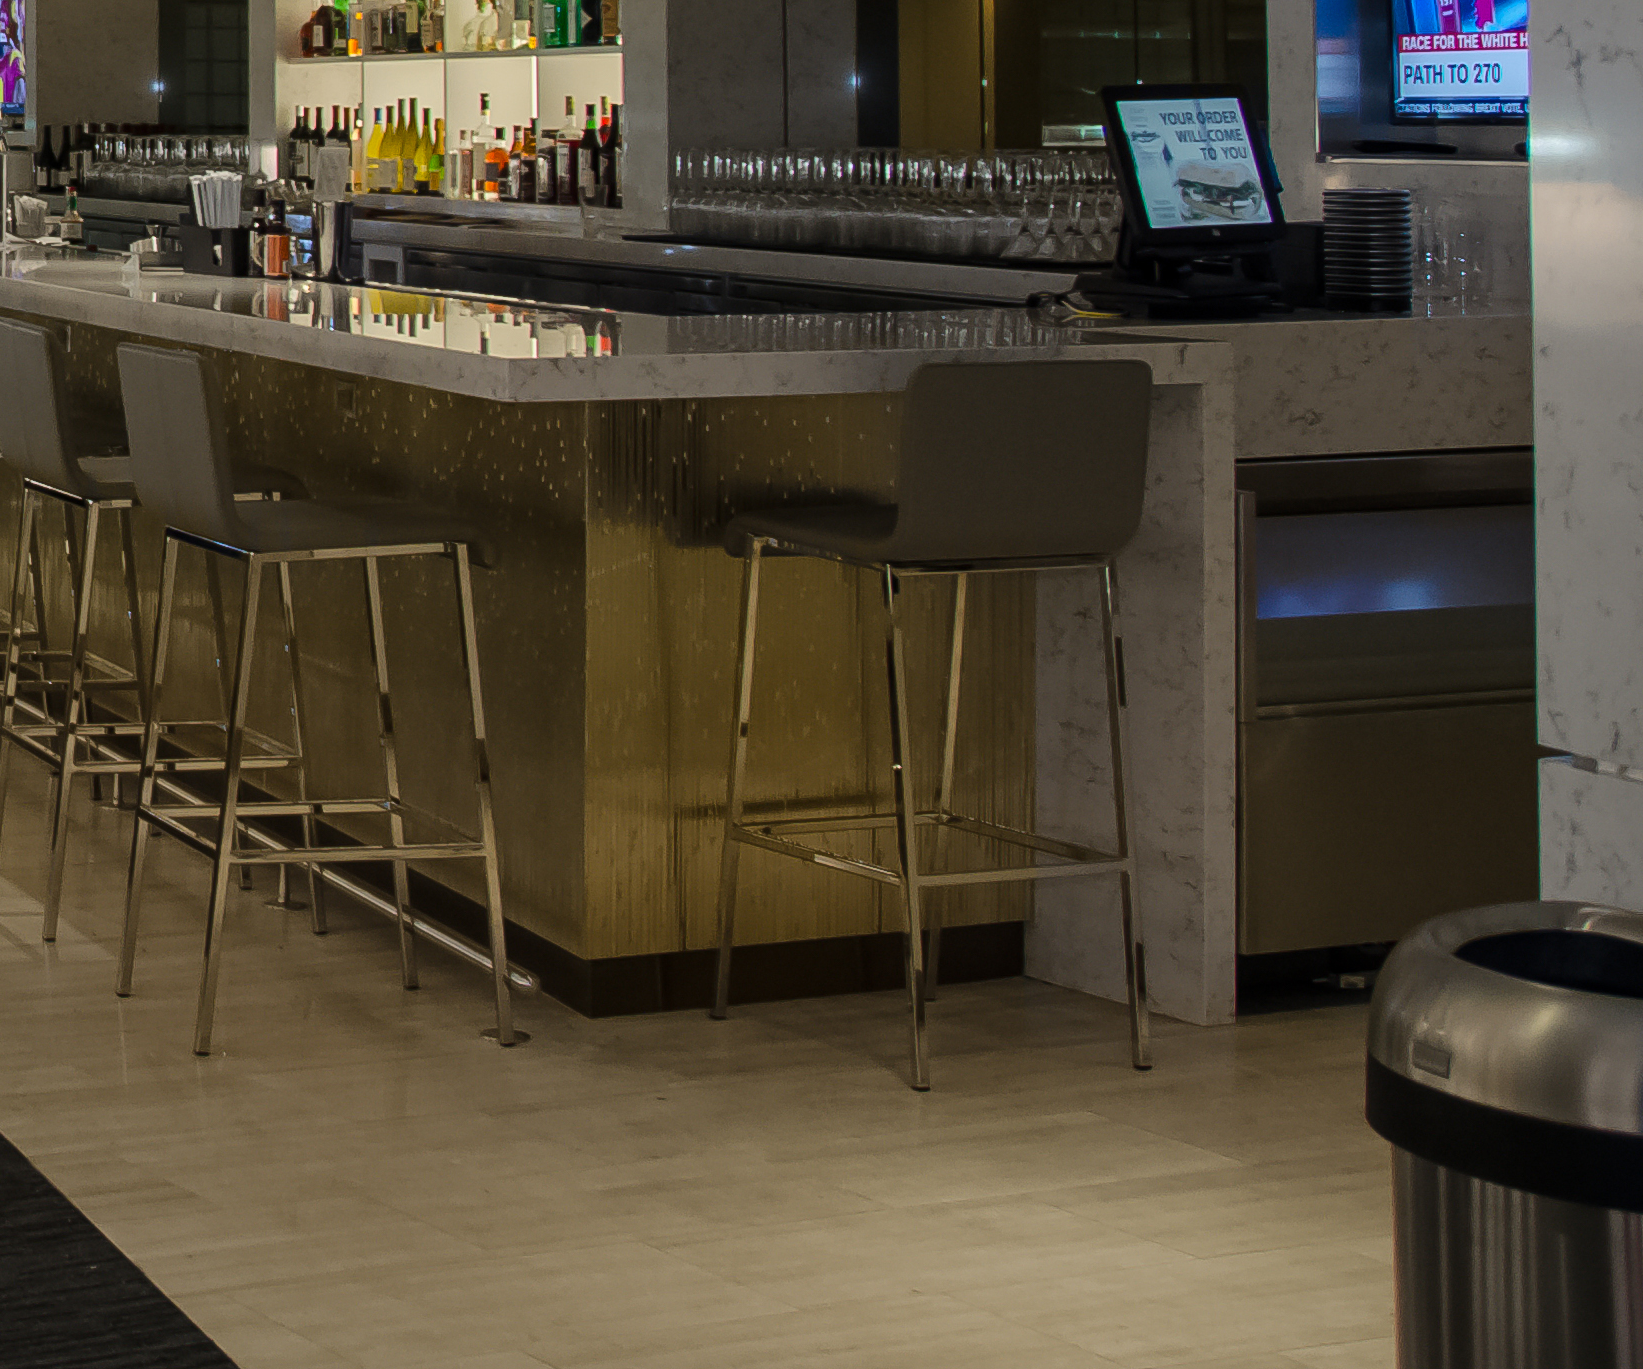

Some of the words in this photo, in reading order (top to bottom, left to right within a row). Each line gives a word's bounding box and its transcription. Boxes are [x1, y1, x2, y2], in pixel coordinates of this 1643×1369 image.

[1402, 35, 1432, 50] RACE
[1433, 35, 1455, 49] FOR
[1457, 34, 1479, 49] THE
[1480, 33, 1518, 48] WHITE
[1403, 63, 1443, 85] PATH
[1447, 63, 1469, 84] TO
[1473, 62, 1502, 84] 270
[1159, 112, 1195, 126] YOUR
[1196, 110, 1239, 125] ORDER
[1175, 129, 1207, 143] WILL
[1206, 128, 1244, 142] COME
[1199, 146, 1217, 161] TO
[1221, 146, 1248, 160] YOU
